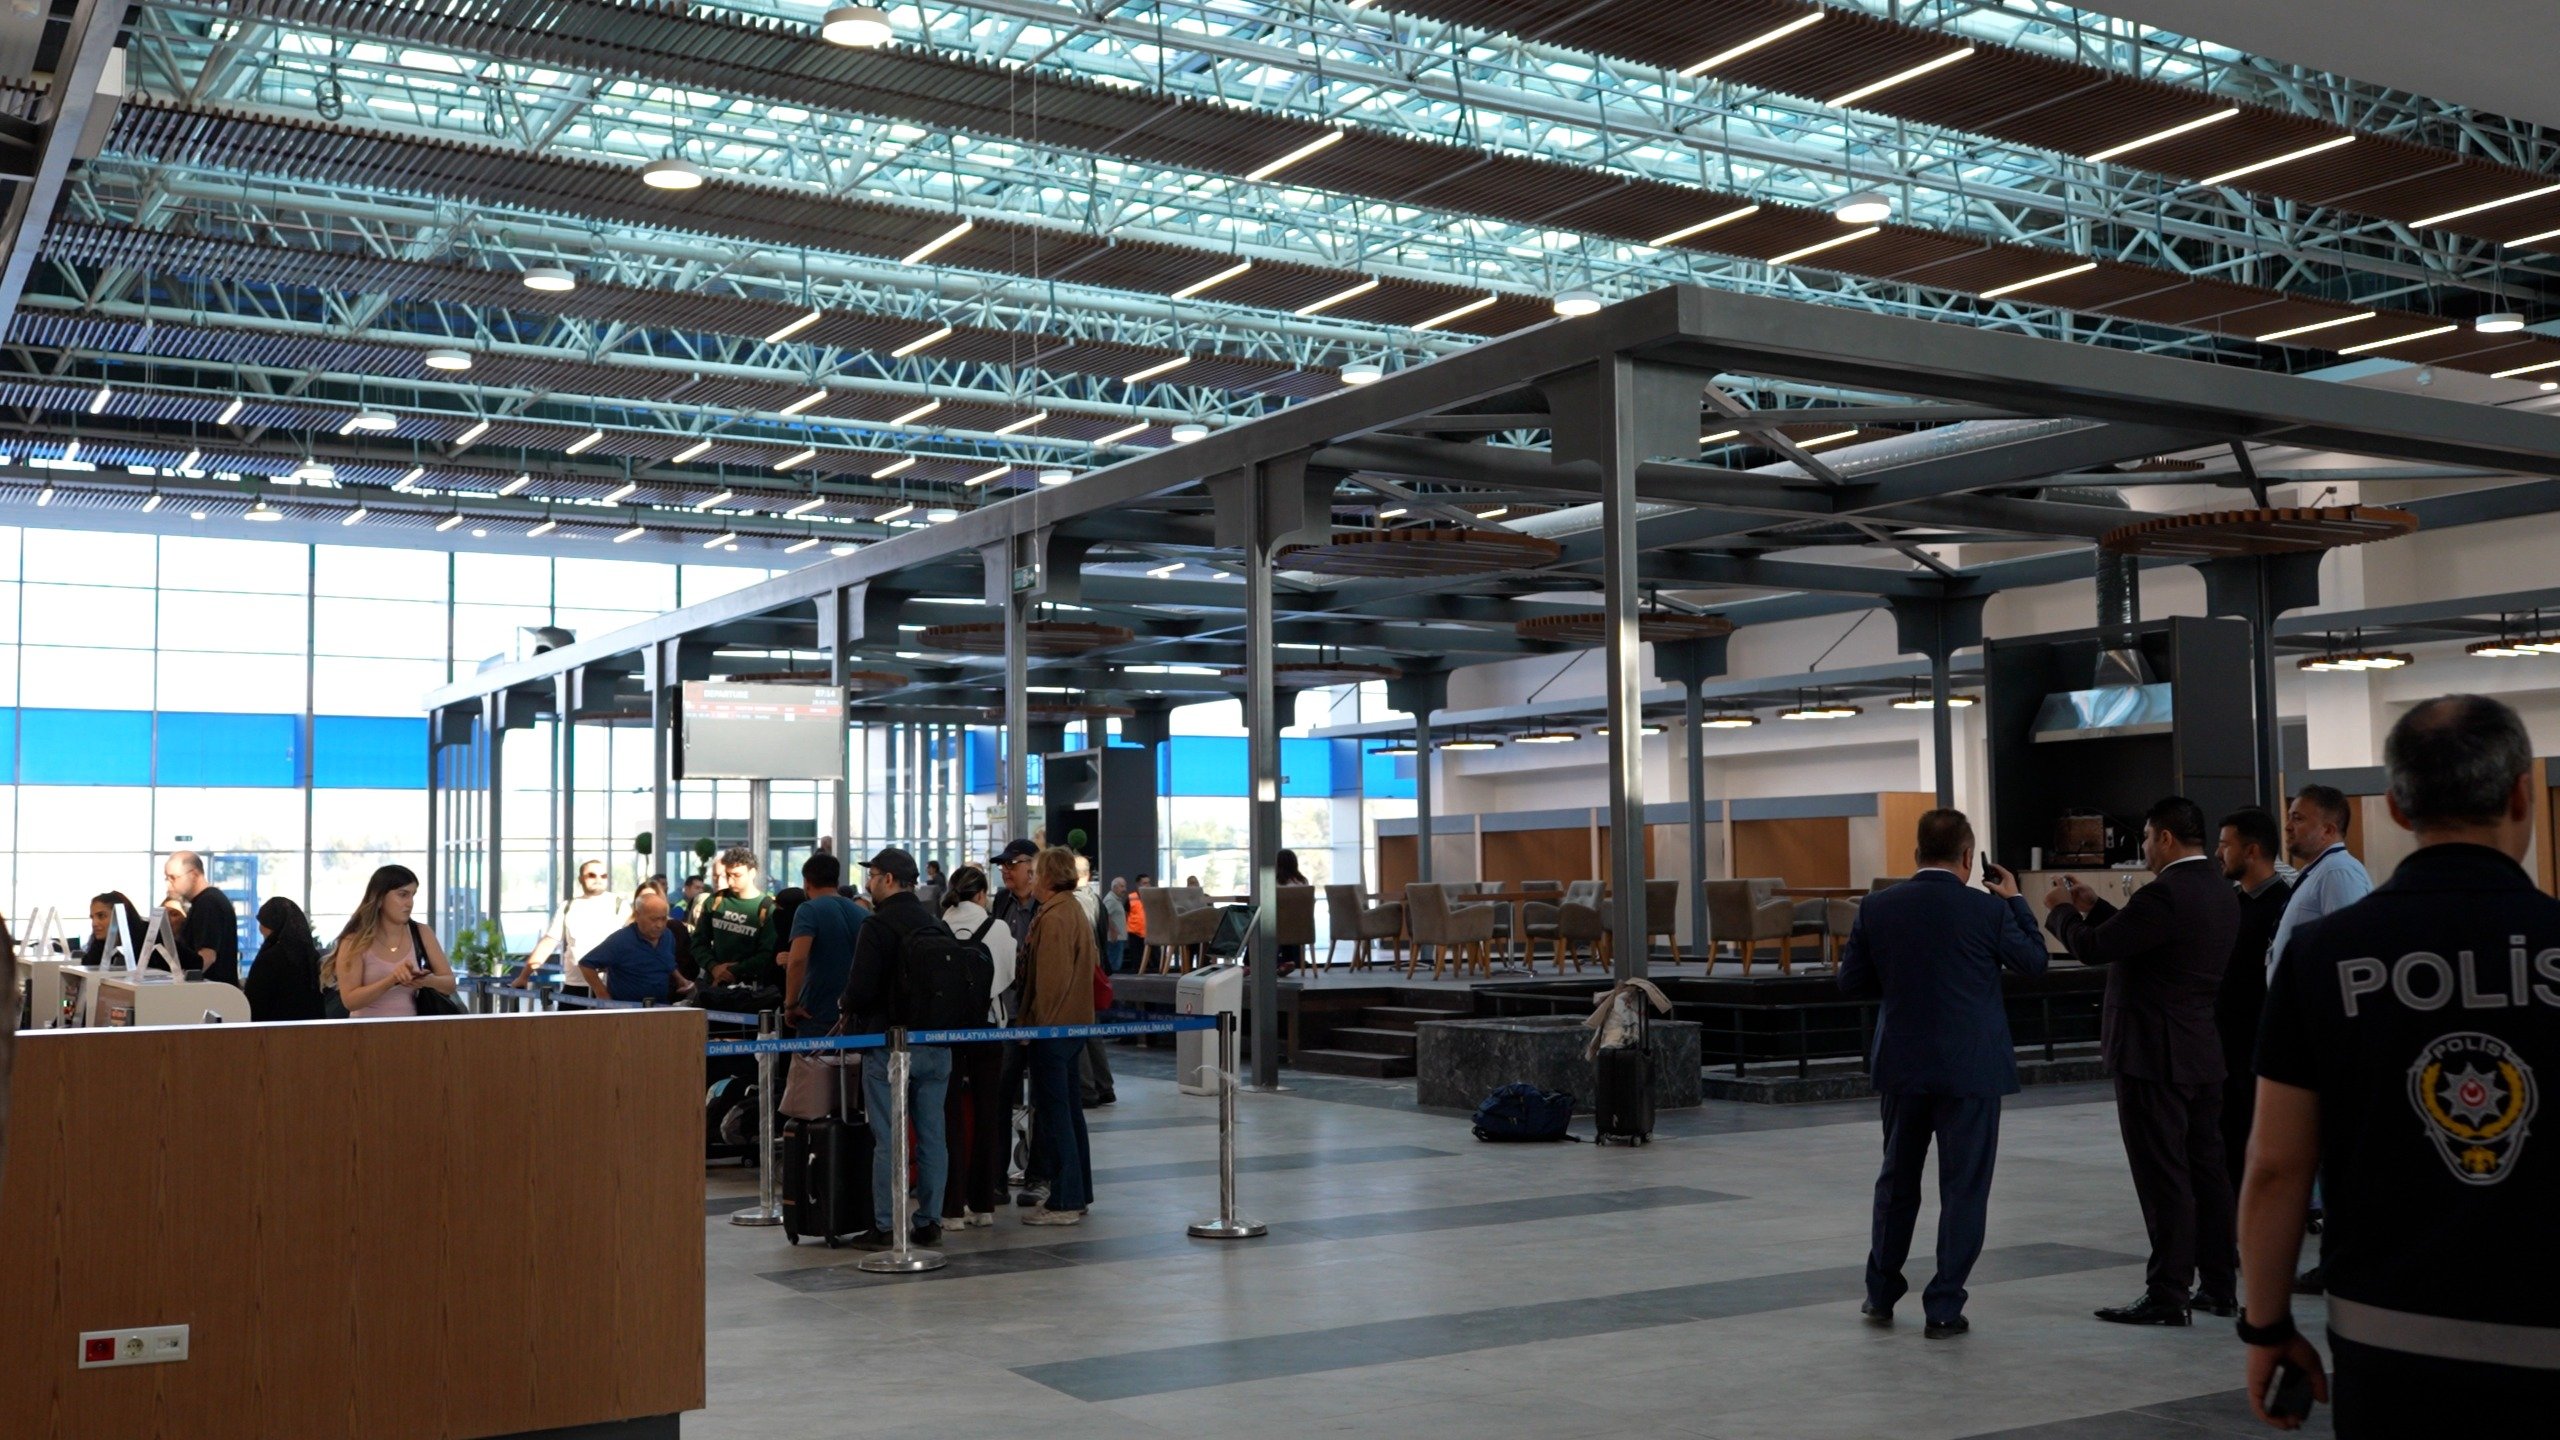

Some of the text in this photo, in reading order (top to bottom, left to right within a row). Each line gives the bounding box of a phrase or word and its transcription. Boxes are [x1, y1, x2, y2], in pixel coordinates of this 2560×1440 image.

[703, 689, 749, 699] DEPARTURE
[723, 910, 748, 924] KOÇ
[711, 917, 758, 937] UNIVERSITY
[948, 1031, 988, 1041] MALATYA
[989, 1029, 1039, 1040] HAVALİMANI
[1089, 1025, 1126, 1036] MALATYA
[709, 1039, 835, 1055] DHMİ MALATYA HAVALİMANI
[2432, 1036, 2502, 1060] POLİS
